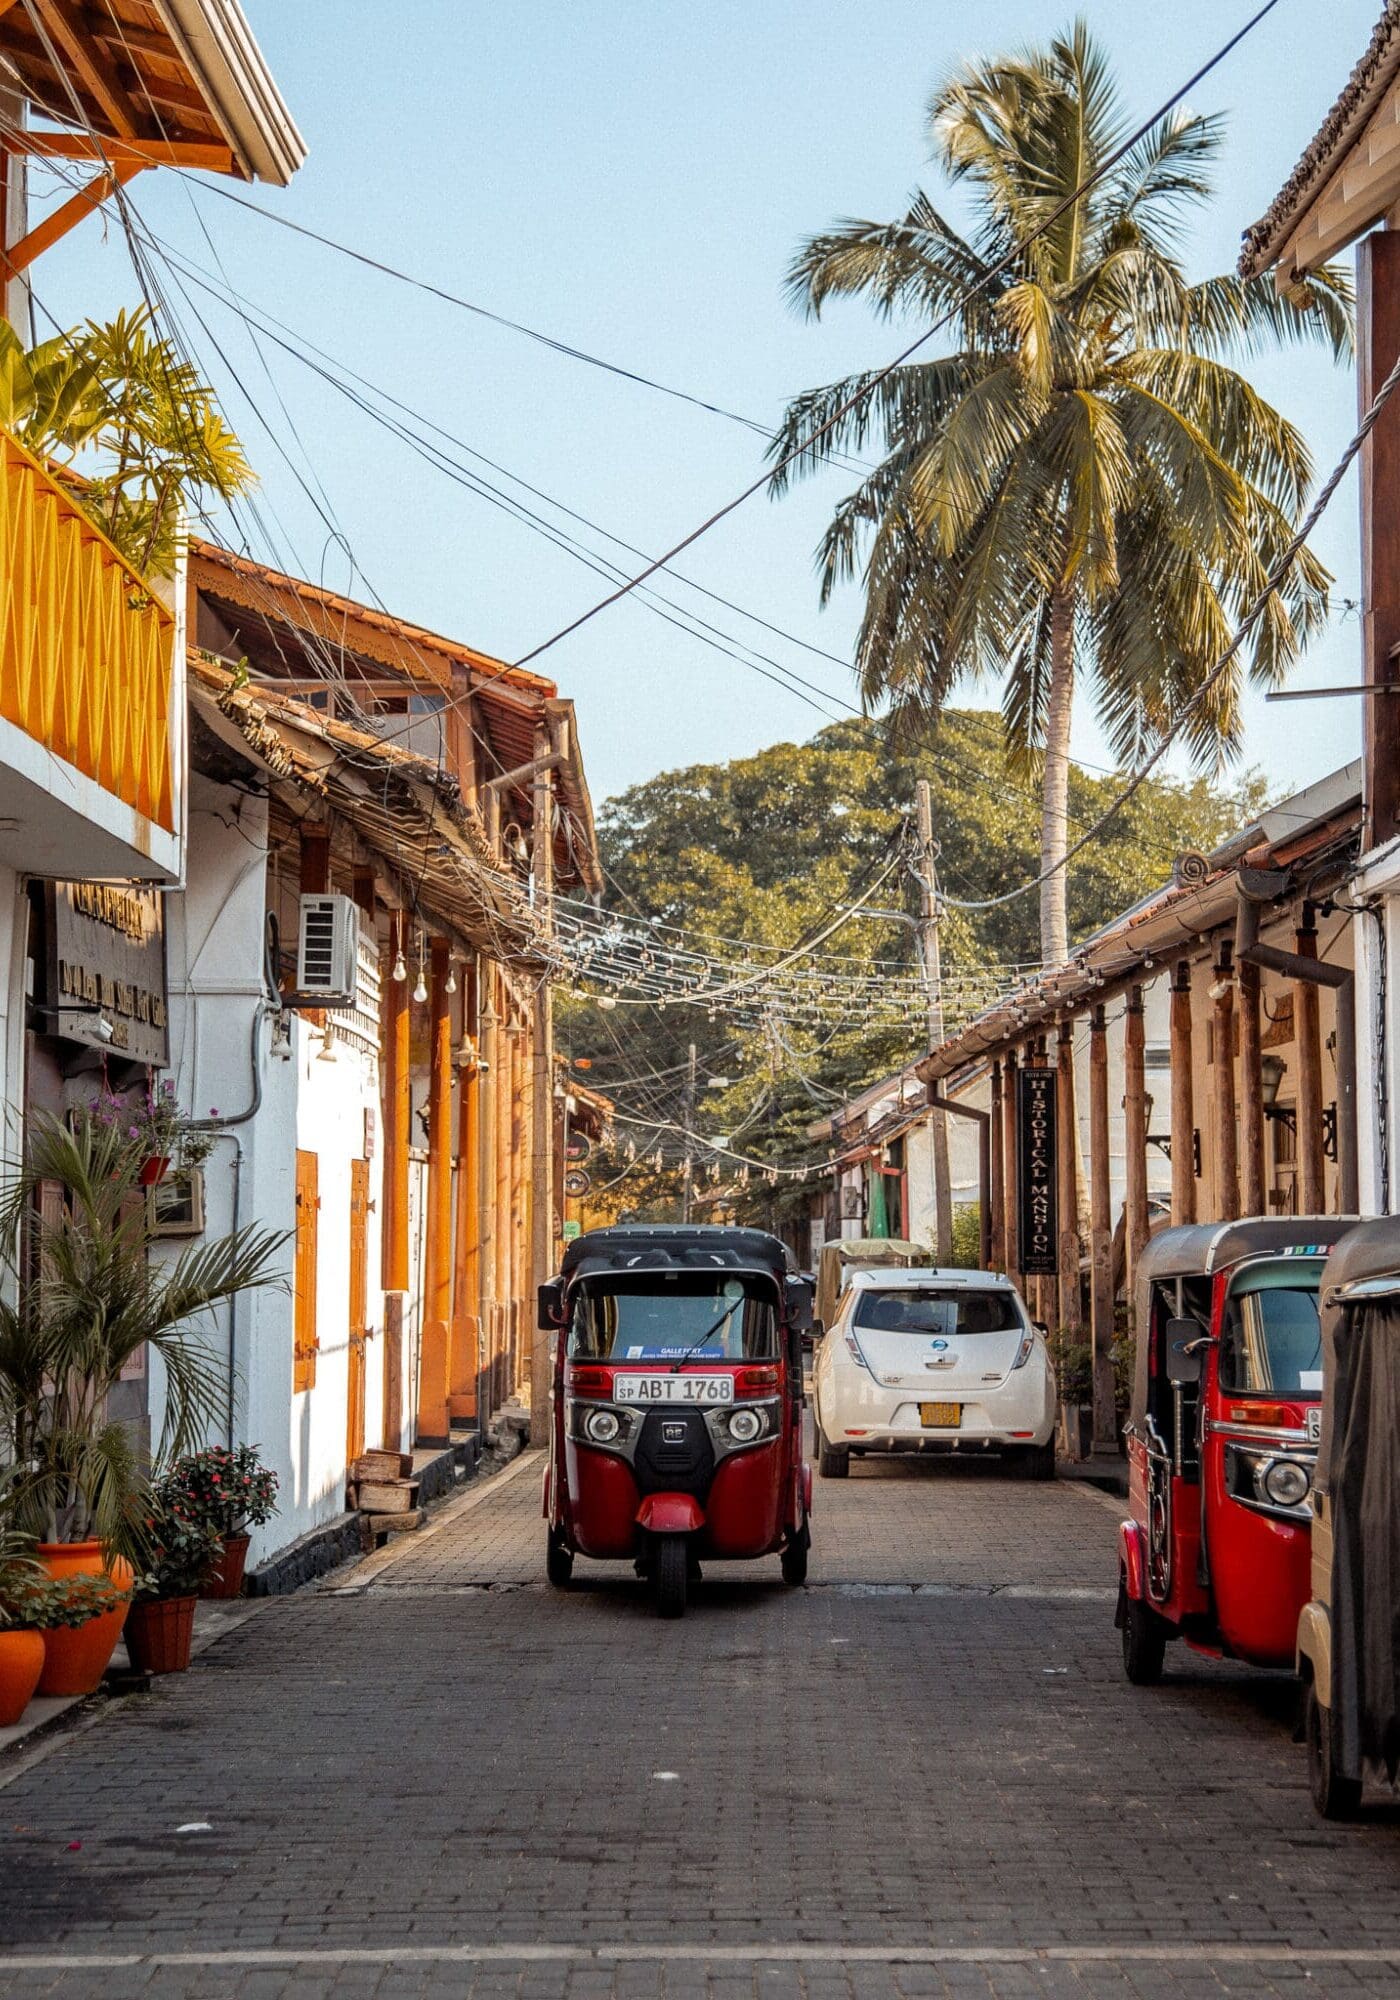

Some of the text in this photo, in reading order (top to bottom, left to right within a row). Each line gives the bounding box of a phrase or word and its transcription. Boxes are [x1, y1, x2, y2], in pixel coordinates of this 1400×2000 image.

[1031, 1081, 1047, 1178] HISTORICAL
[1031, 1185, 1048, 1253] MANSION
[619, 1380, 730, 1399] SP ABT 1768
[666, 1429, 683, 1438] RE
